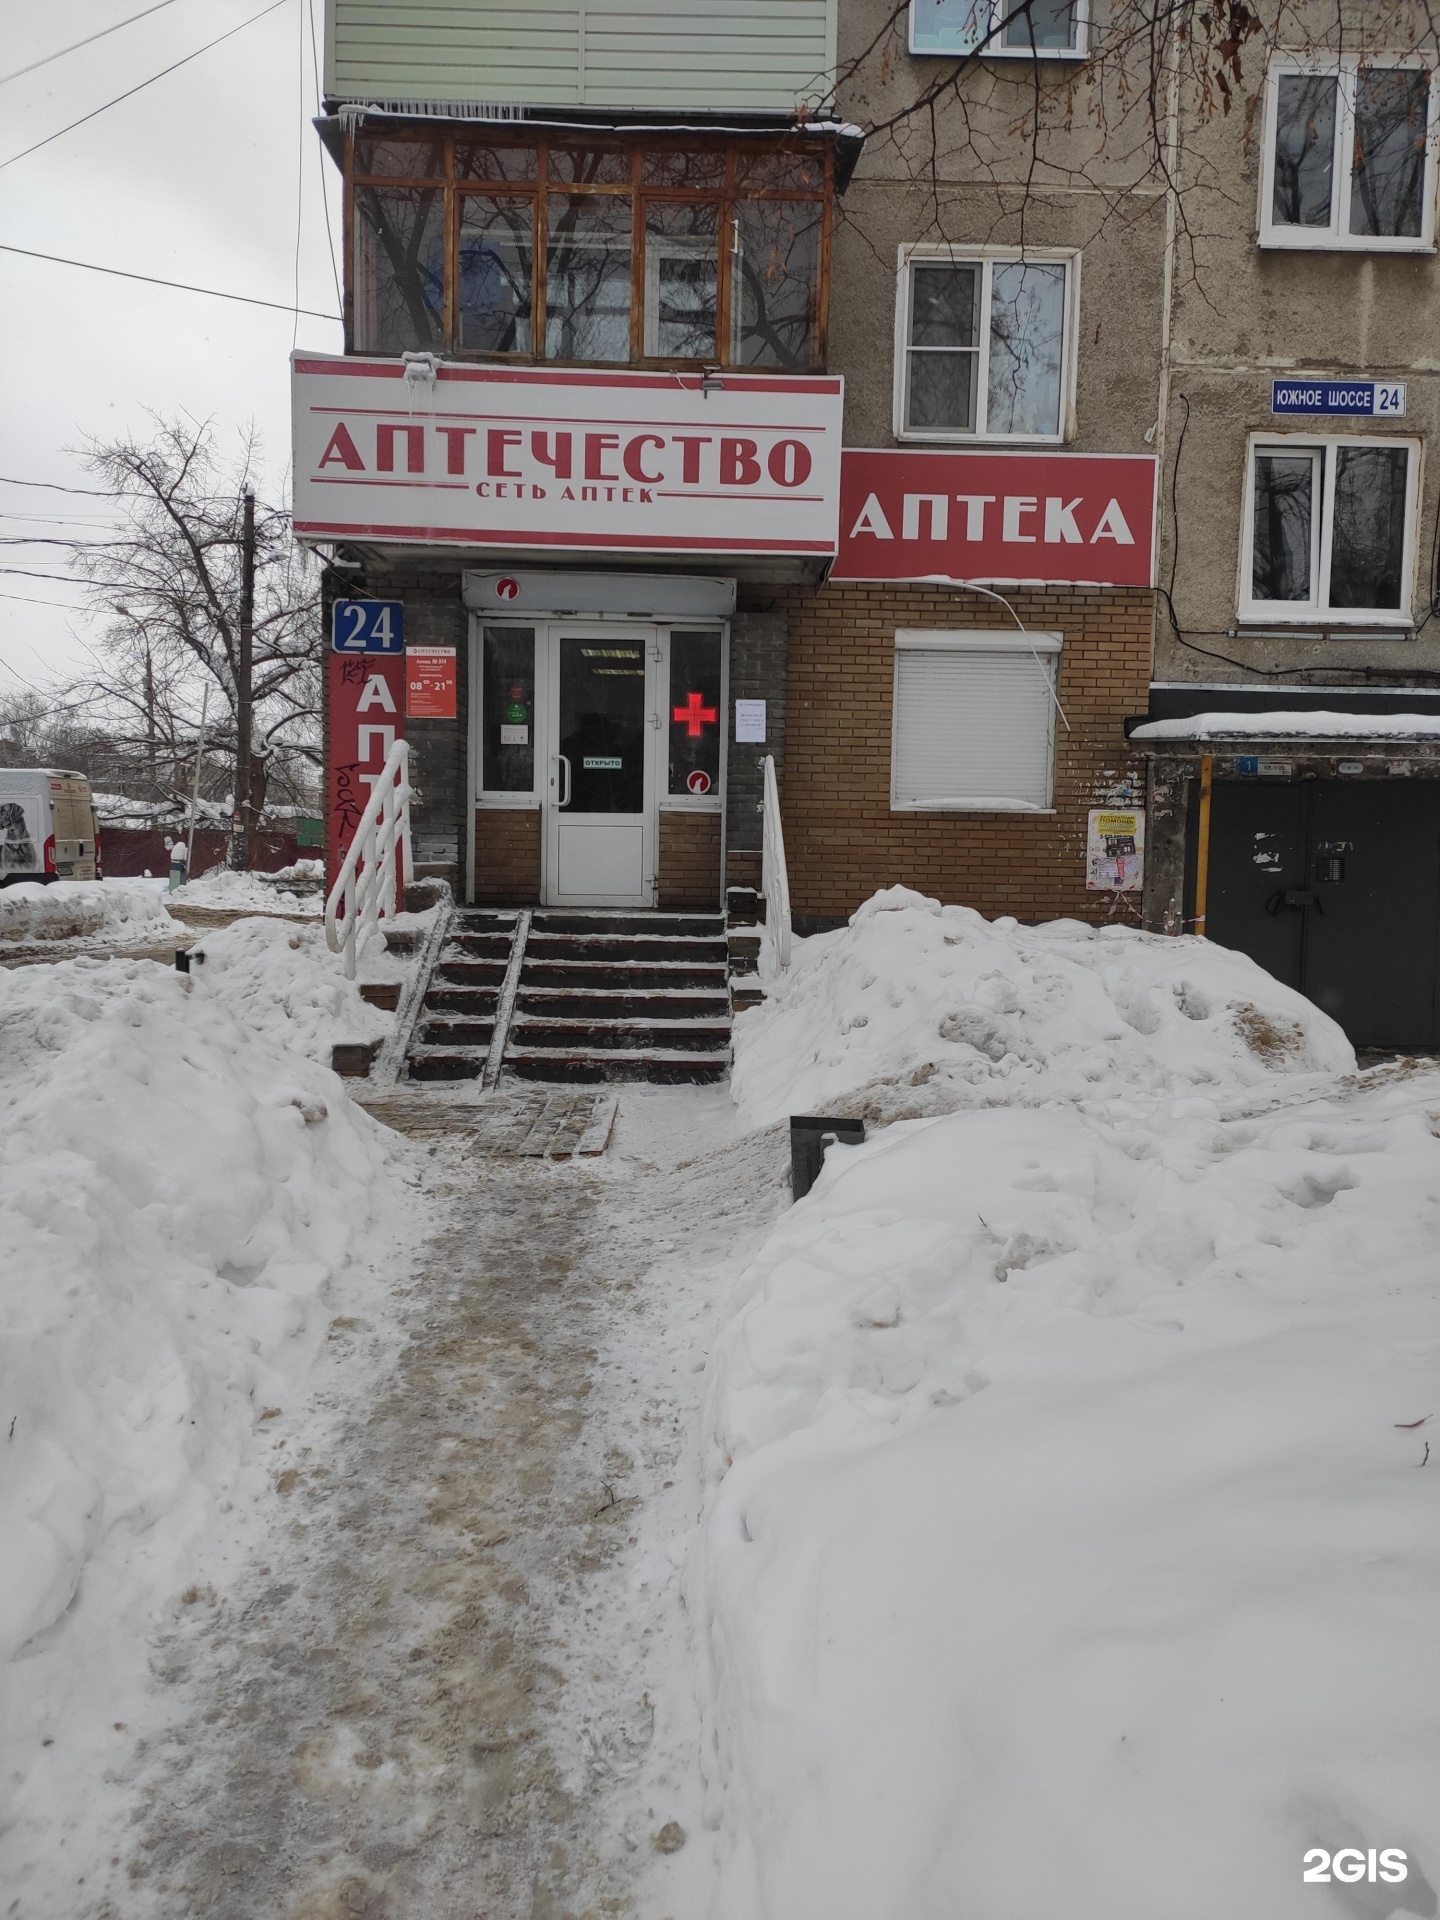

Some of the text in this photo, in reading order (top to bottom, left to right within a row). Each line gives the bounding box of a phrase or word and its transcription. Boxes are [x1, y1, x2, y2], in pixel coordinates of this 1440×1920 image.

[1276, 388, 1400, 410] ЮЖНОЕ ШОССЕ 24
[318, 422, 812, 487] АПТЕЧЕСТВО
[475, 482, 653, 503] СЕТЬ АПТЕК
[849, 492, 1136, 545] АПТЕКА
[343, 605, 395, 648] 24
